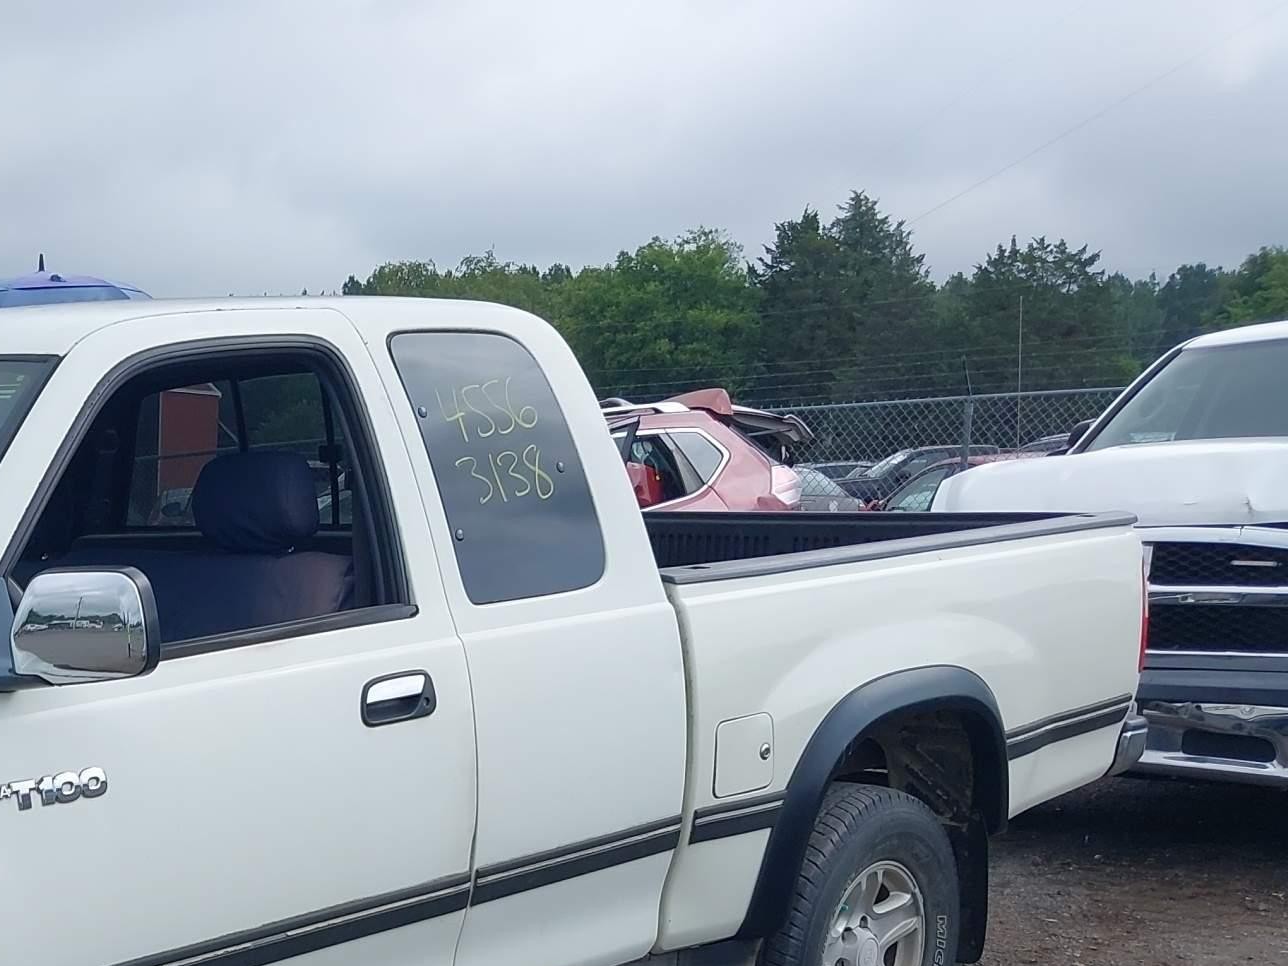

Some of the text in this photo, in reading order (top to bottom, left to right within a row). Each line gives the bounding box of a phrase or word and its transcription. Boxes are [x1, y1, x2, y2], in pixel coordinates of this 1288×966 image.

[435, 376, 538, 442] 4556
[455, 444, 554, 504] 3138
[9, 766, 108, 811] T100
